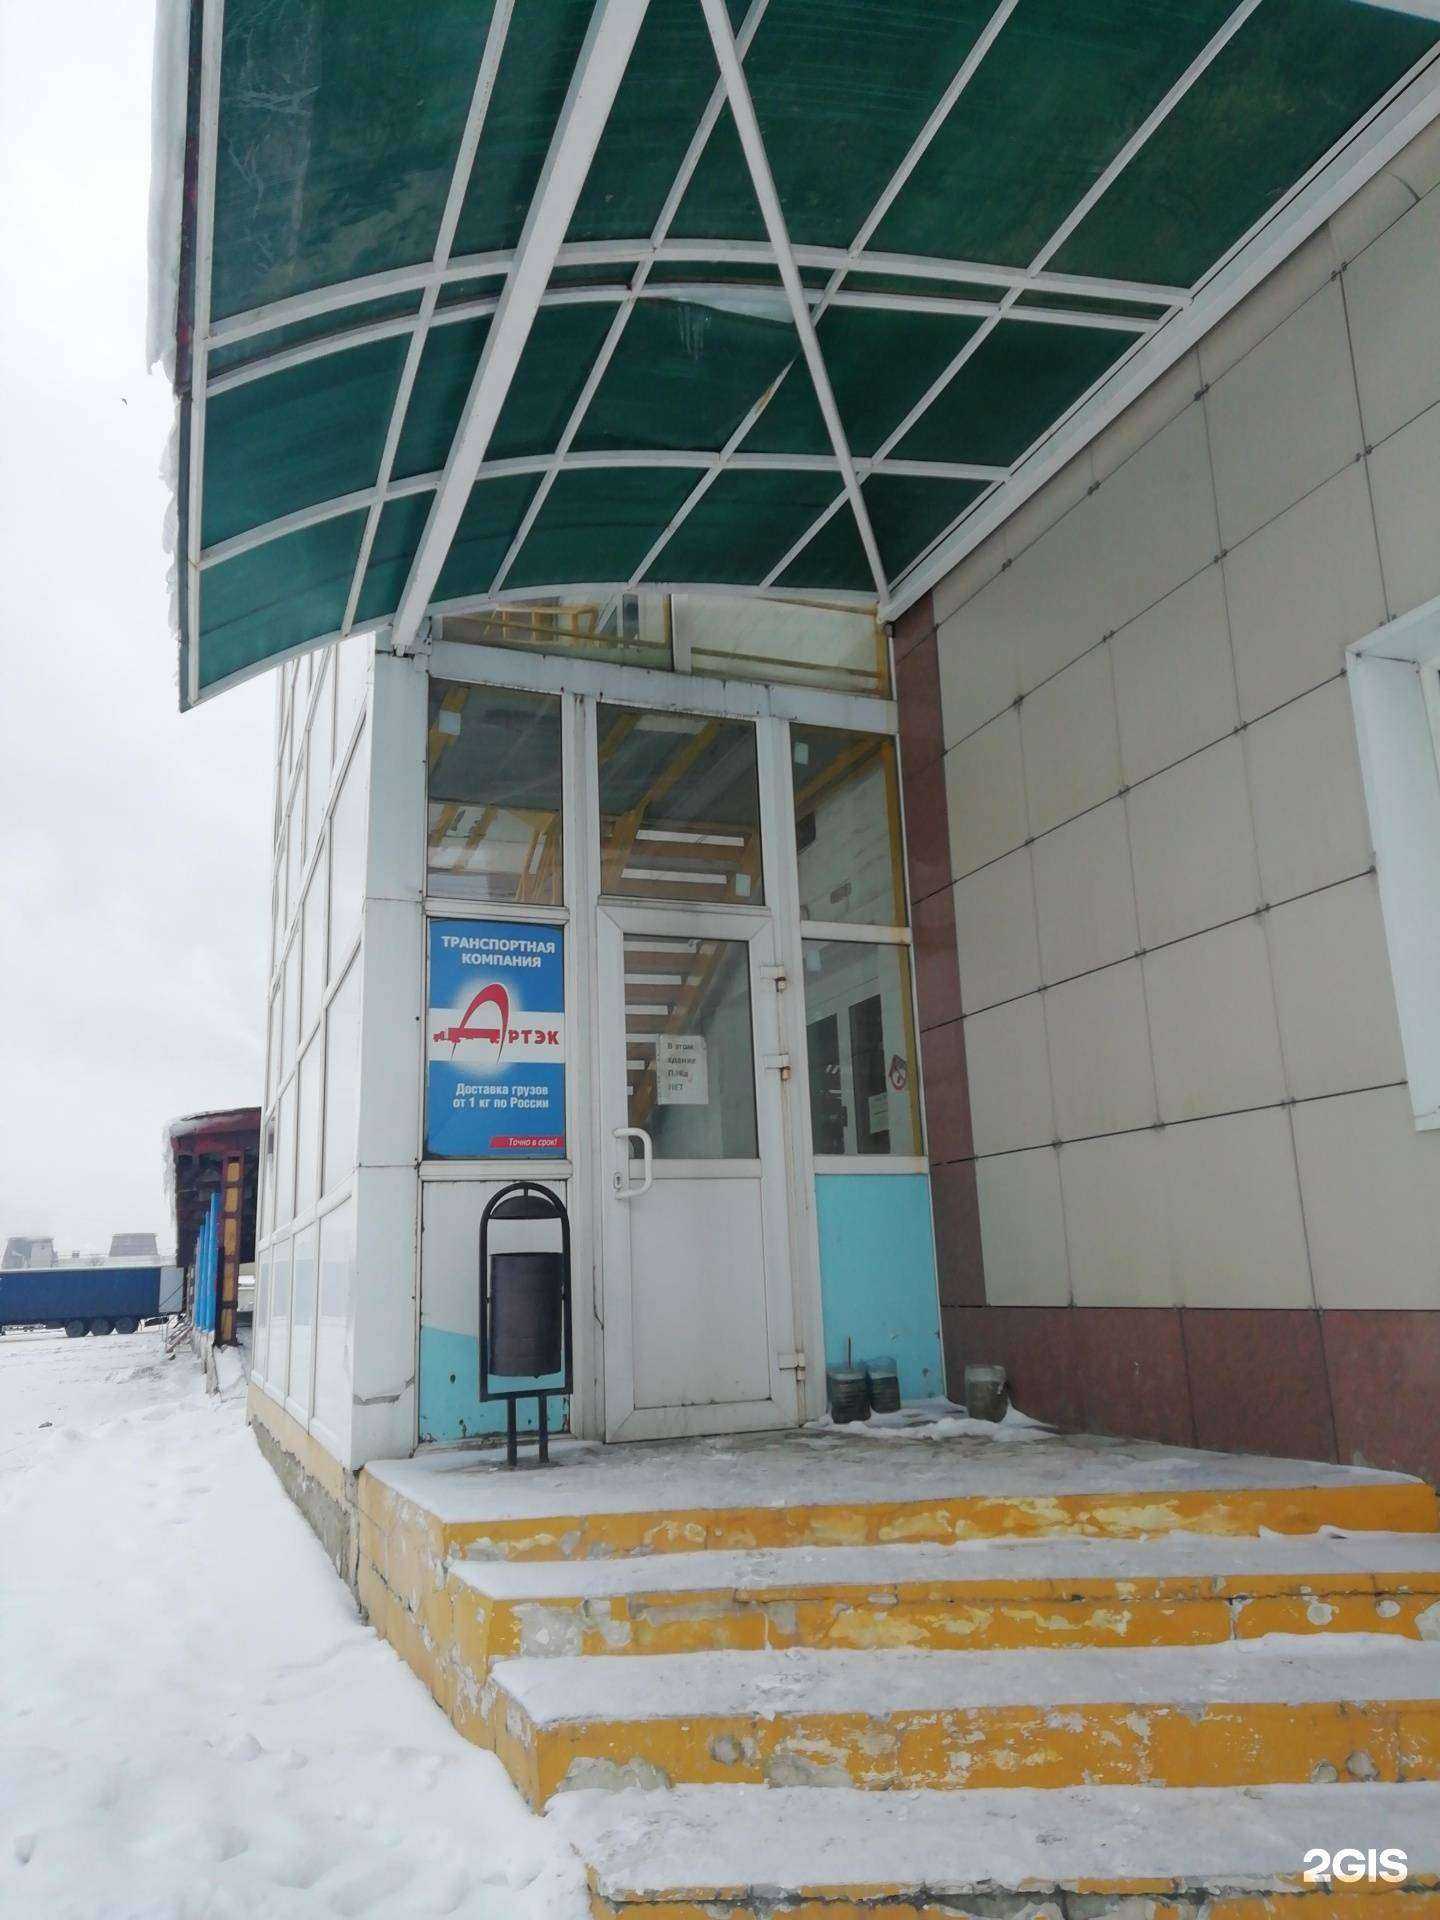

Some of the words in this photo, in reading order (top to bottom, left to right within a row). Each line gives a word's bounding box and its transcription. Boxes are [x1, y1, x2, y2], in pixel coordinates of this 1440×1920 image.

[441, 936, 556, 954] ТРАНСПОРТНАЯ
[461, 953, 542, 968] КОМПАНИЯ
[456, 1083, 509, 1097] Доставка
[512, 1085, 549, 1097] грузов
[452, 1098, 467, 1109] от
[468, 1097, 475, 1109] 1
[479, 1098, 492, 1109] кг
[494, 1098, 508, 1109] по
[510, 1096, 549, 1109] России
[508, 1137, 531, 1147] Точно
[537, 1138, 557, 1148] срок!
